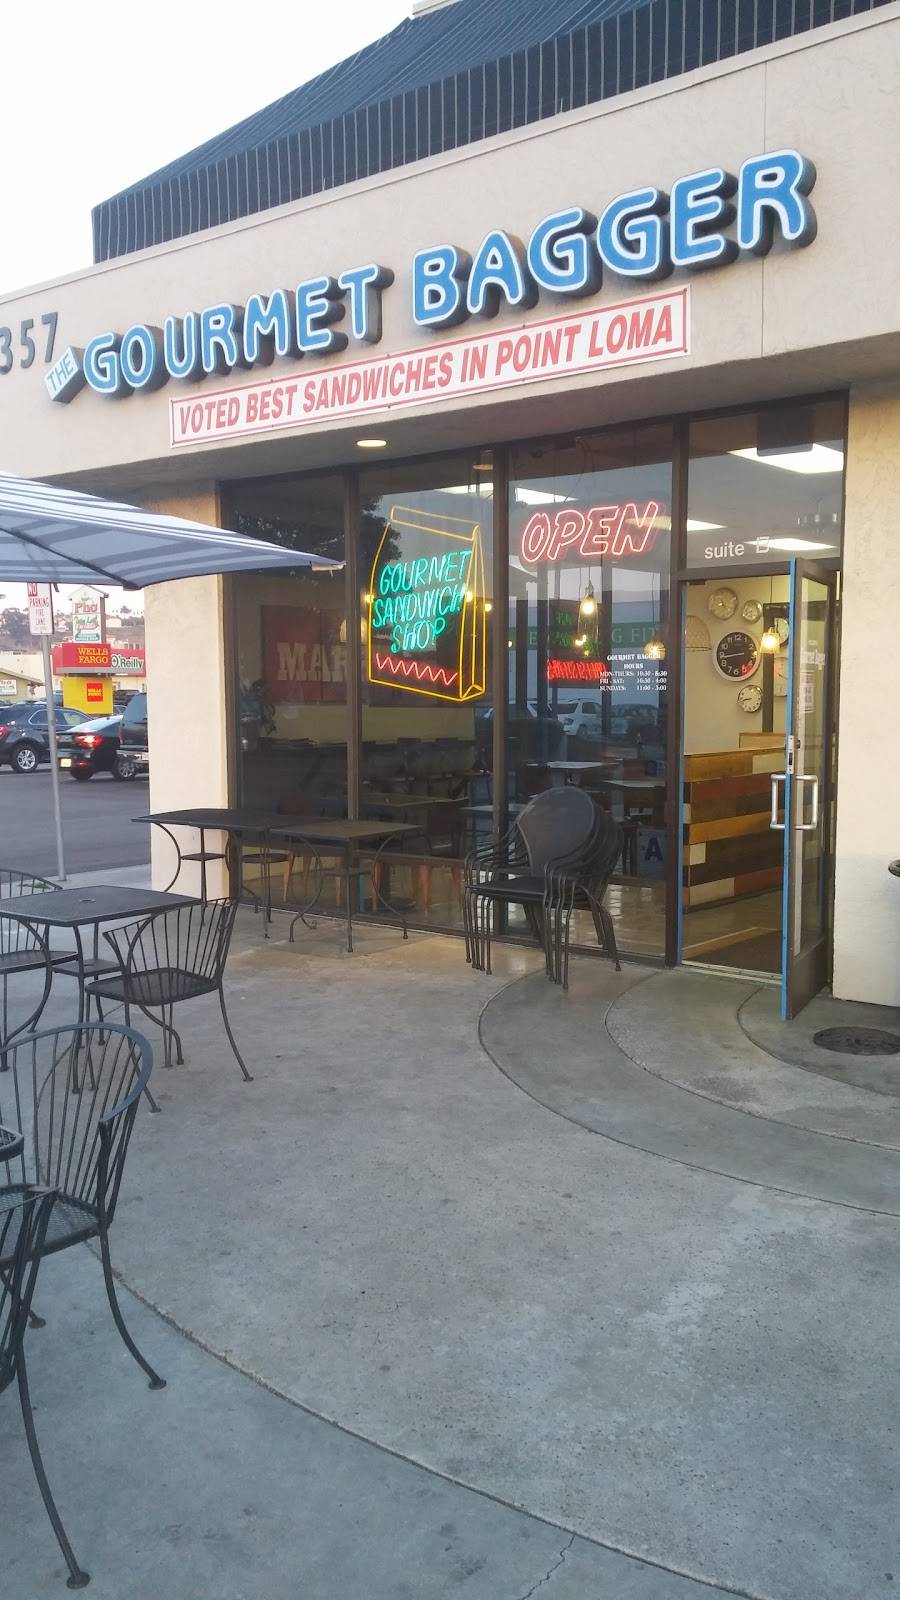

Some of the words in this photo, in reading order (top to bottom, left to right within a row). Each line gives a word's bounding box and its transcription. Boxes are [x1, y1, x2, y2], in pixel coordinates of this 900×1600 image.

[46, 353, 75, 393] THE
[83, 263, 384, 394] GOURMET
[412, 148, 807, 326] BAGGER
[0, 312, 58, 375] 357
[180, 401, 240, 434] VOTED
[246, 391, 295, 423] BEST
[303, 350, 452, 414] SANDWICHES
[460, 345, 488, 381] IN
[495, 324, 583, 377] POINT
[588, 304, 674, 359] LOMA
[521, 500, 660, 563] OPEN
[704, 540, 745, 559] suite
[756, 536, 770, 554] B
[28, 582, 38, 596] NO
[379, 550, 473, 596] GOURMET
[29, 597, 49, 607] PARKING
[371, 583, 467, 628] SANDWICH
[78, 647, 109, 656] WELLS
[390, 617, 446, 654] SHOP
[79, 655, 109, 664] FARGO
[645, 837, 664, 861] A
